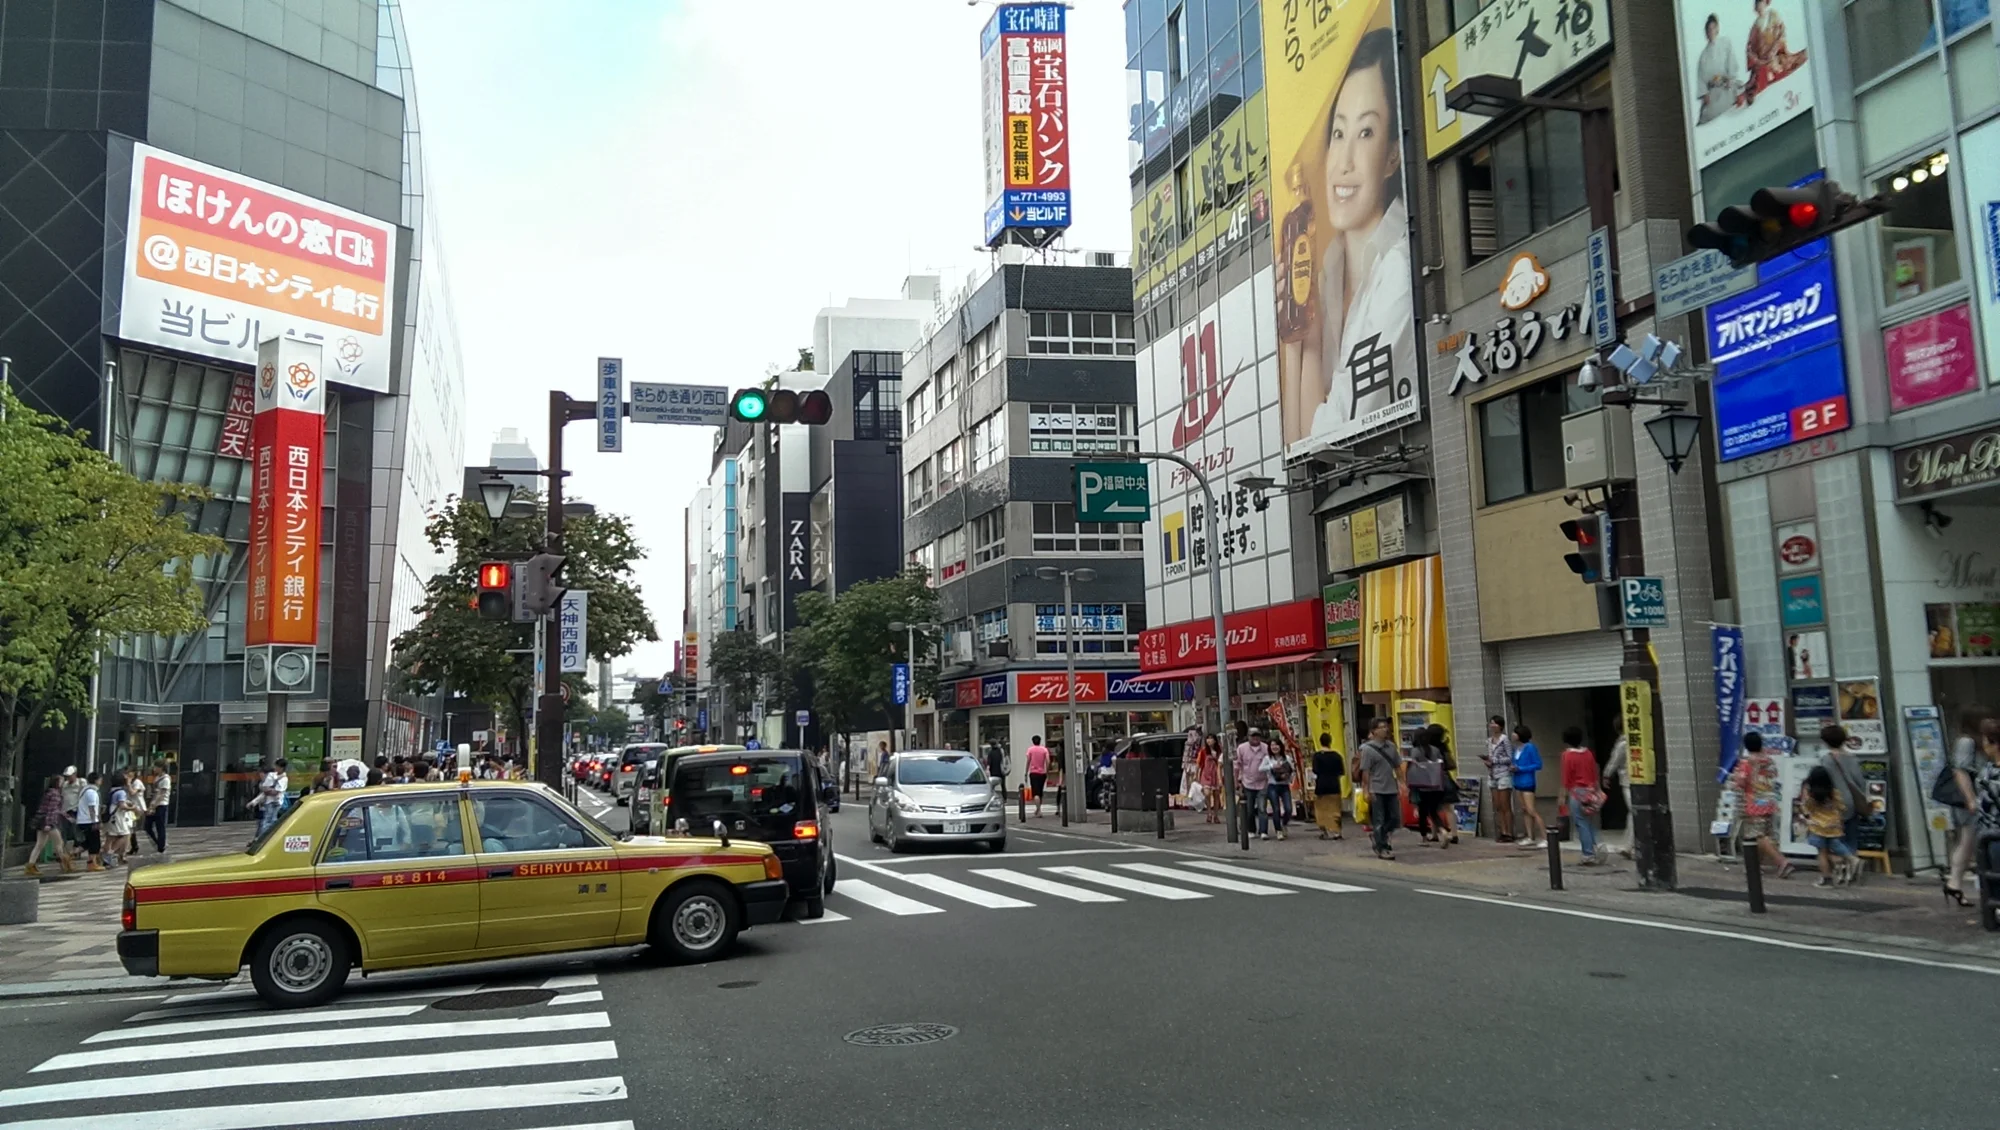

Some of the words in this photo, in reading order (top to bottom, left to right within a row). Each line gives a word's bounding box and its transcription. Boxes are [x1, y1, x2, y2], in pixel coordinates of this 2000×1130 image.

[1004, 7, 1060, 31] 宝石・時計
[1033, 37, 1062, 53] 福岡
[1006, 37, 1032, 115] 高価買取
[1033, 54, 1064, 185] 宝石バンク
[1012, 120, 1030, 181] 査定無料
[1026, 206, 1067, 222] 当ビル1F
[1227, 202, 1248, 241] 4F
[184, 245, 379, 321] 西日本シティ銀行
[1658, 252, 1732, 291] きらめき通り
[1716, 282, 1822, 349] アパマンショップ
[602, 362, 618, 449] 歩車分離信号
[633, 387, 727, 406] きらめき通り西口
[1382, 399, 1414, 417] SUNTORY
[634, 404, 684, 415] Kirameki-dori
[686, 406, 725, 417] Nishiguchi
[1801, 403, 1838, 432] 2F
[1079, 470, 1103, 513] P
[1103, 475, 1147, 491] 福岡中央
[253, 445, 272, 621] 西日本シティ銀行
[283, 445, 310, 621] 西日本シティ銀行
[1192, 522, 1257, 568] 使ます。
[789, 520, 805, 581] ZARA
[1165, 562, 1187, 577] T-POINT
[1624, 579, 1641, 602] P
[560, 598, 579, 668] 天神西通り
[1143, 632, 1166, 649] くすり
[1194, 625, 1258, 651] ドラッイレブン
[1274, 633, 1308, 648] 天神西通り店
[1144, 649, 1167, 666] 化粧品
[1029, 681, 1096, 699] ダイレクト
[1108, 679, 1165, 695] DIRECT
[382, 874, 404, 886] 福交
[411, 872, 446, 883] 814
[519, 862, 573, 875] SEIRYU
[576, 860, 609, 872] TAXI
